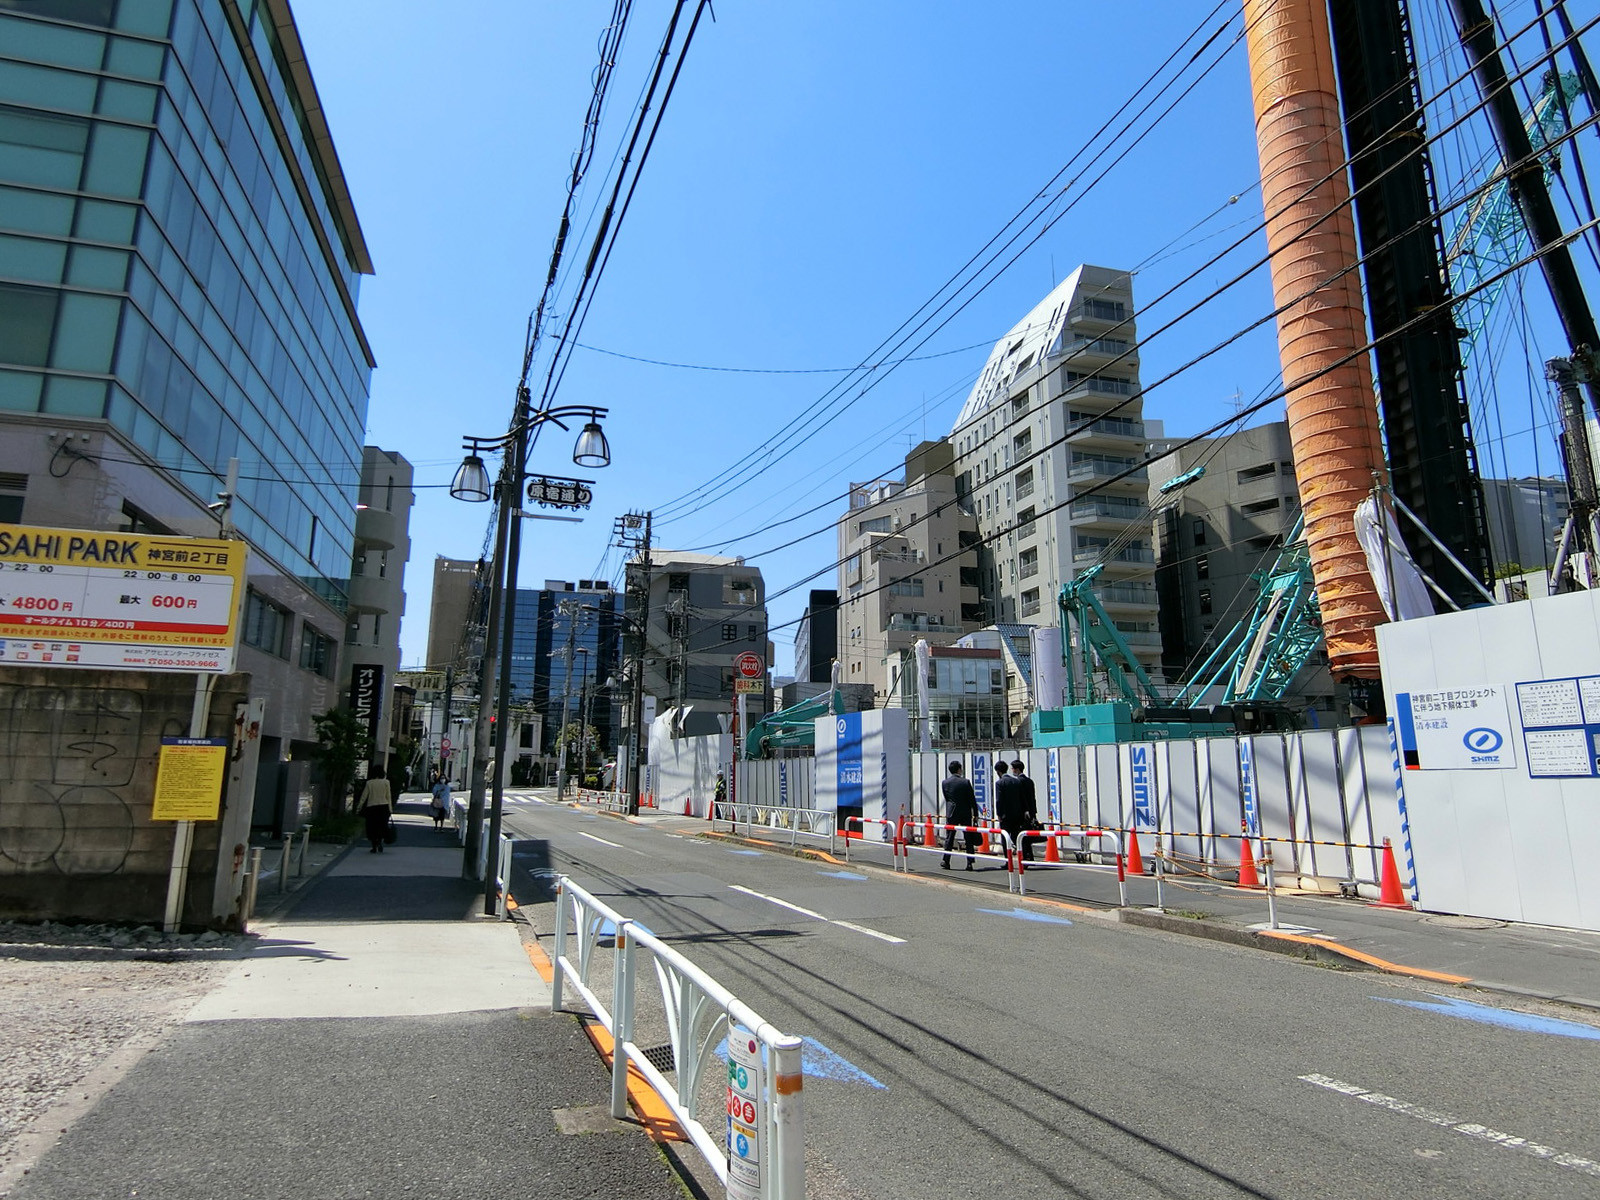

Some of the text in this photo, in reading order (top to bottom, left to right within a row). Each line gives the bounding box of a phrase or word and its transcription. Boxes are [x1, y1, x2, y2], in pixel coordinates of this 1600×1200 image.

[530, 485, 590, 503] 原宿通り
[67, 537, 140, 564] PARK
[148, 549, 228, 565] 神宮前2丁目
[120, 595, 141, 604] 最大
[1412, 688, 1497, 703] 神宮前二丁目プロジェクト
[1414, 700, 1478, 712] に伴う地下解体工事
[974, 755, 986, 816] SHMZ
[1047, 752, 1059, 820] SHMZ
[1132, 747, 1150, 826] SHMZ
[1240, 742, 1256, 833] SHMZ
